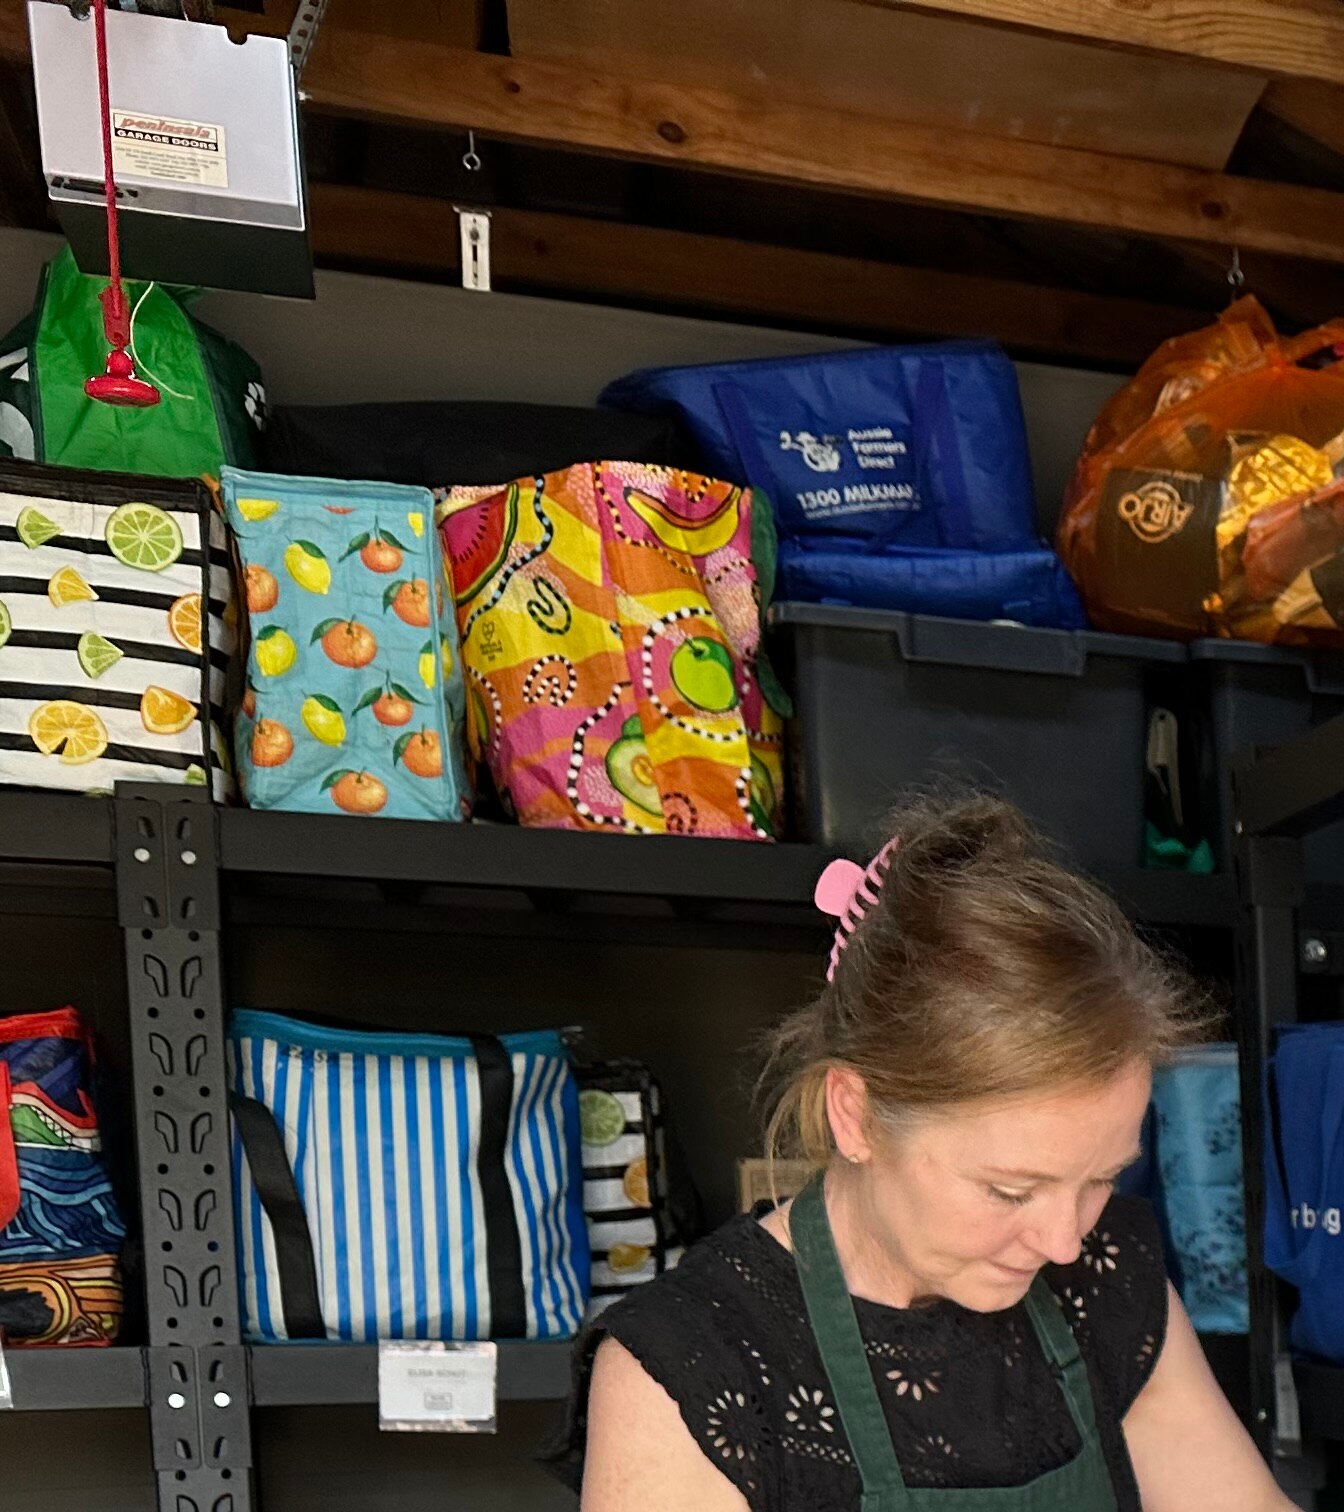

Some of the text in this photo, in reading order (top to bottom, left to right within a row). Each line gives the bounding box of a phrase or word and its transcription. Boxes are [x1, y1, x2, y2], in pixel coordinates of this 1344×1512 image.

[117, 130, 217, 151] GARAGE DOORS
[796, 487, 841, 510] 1300
